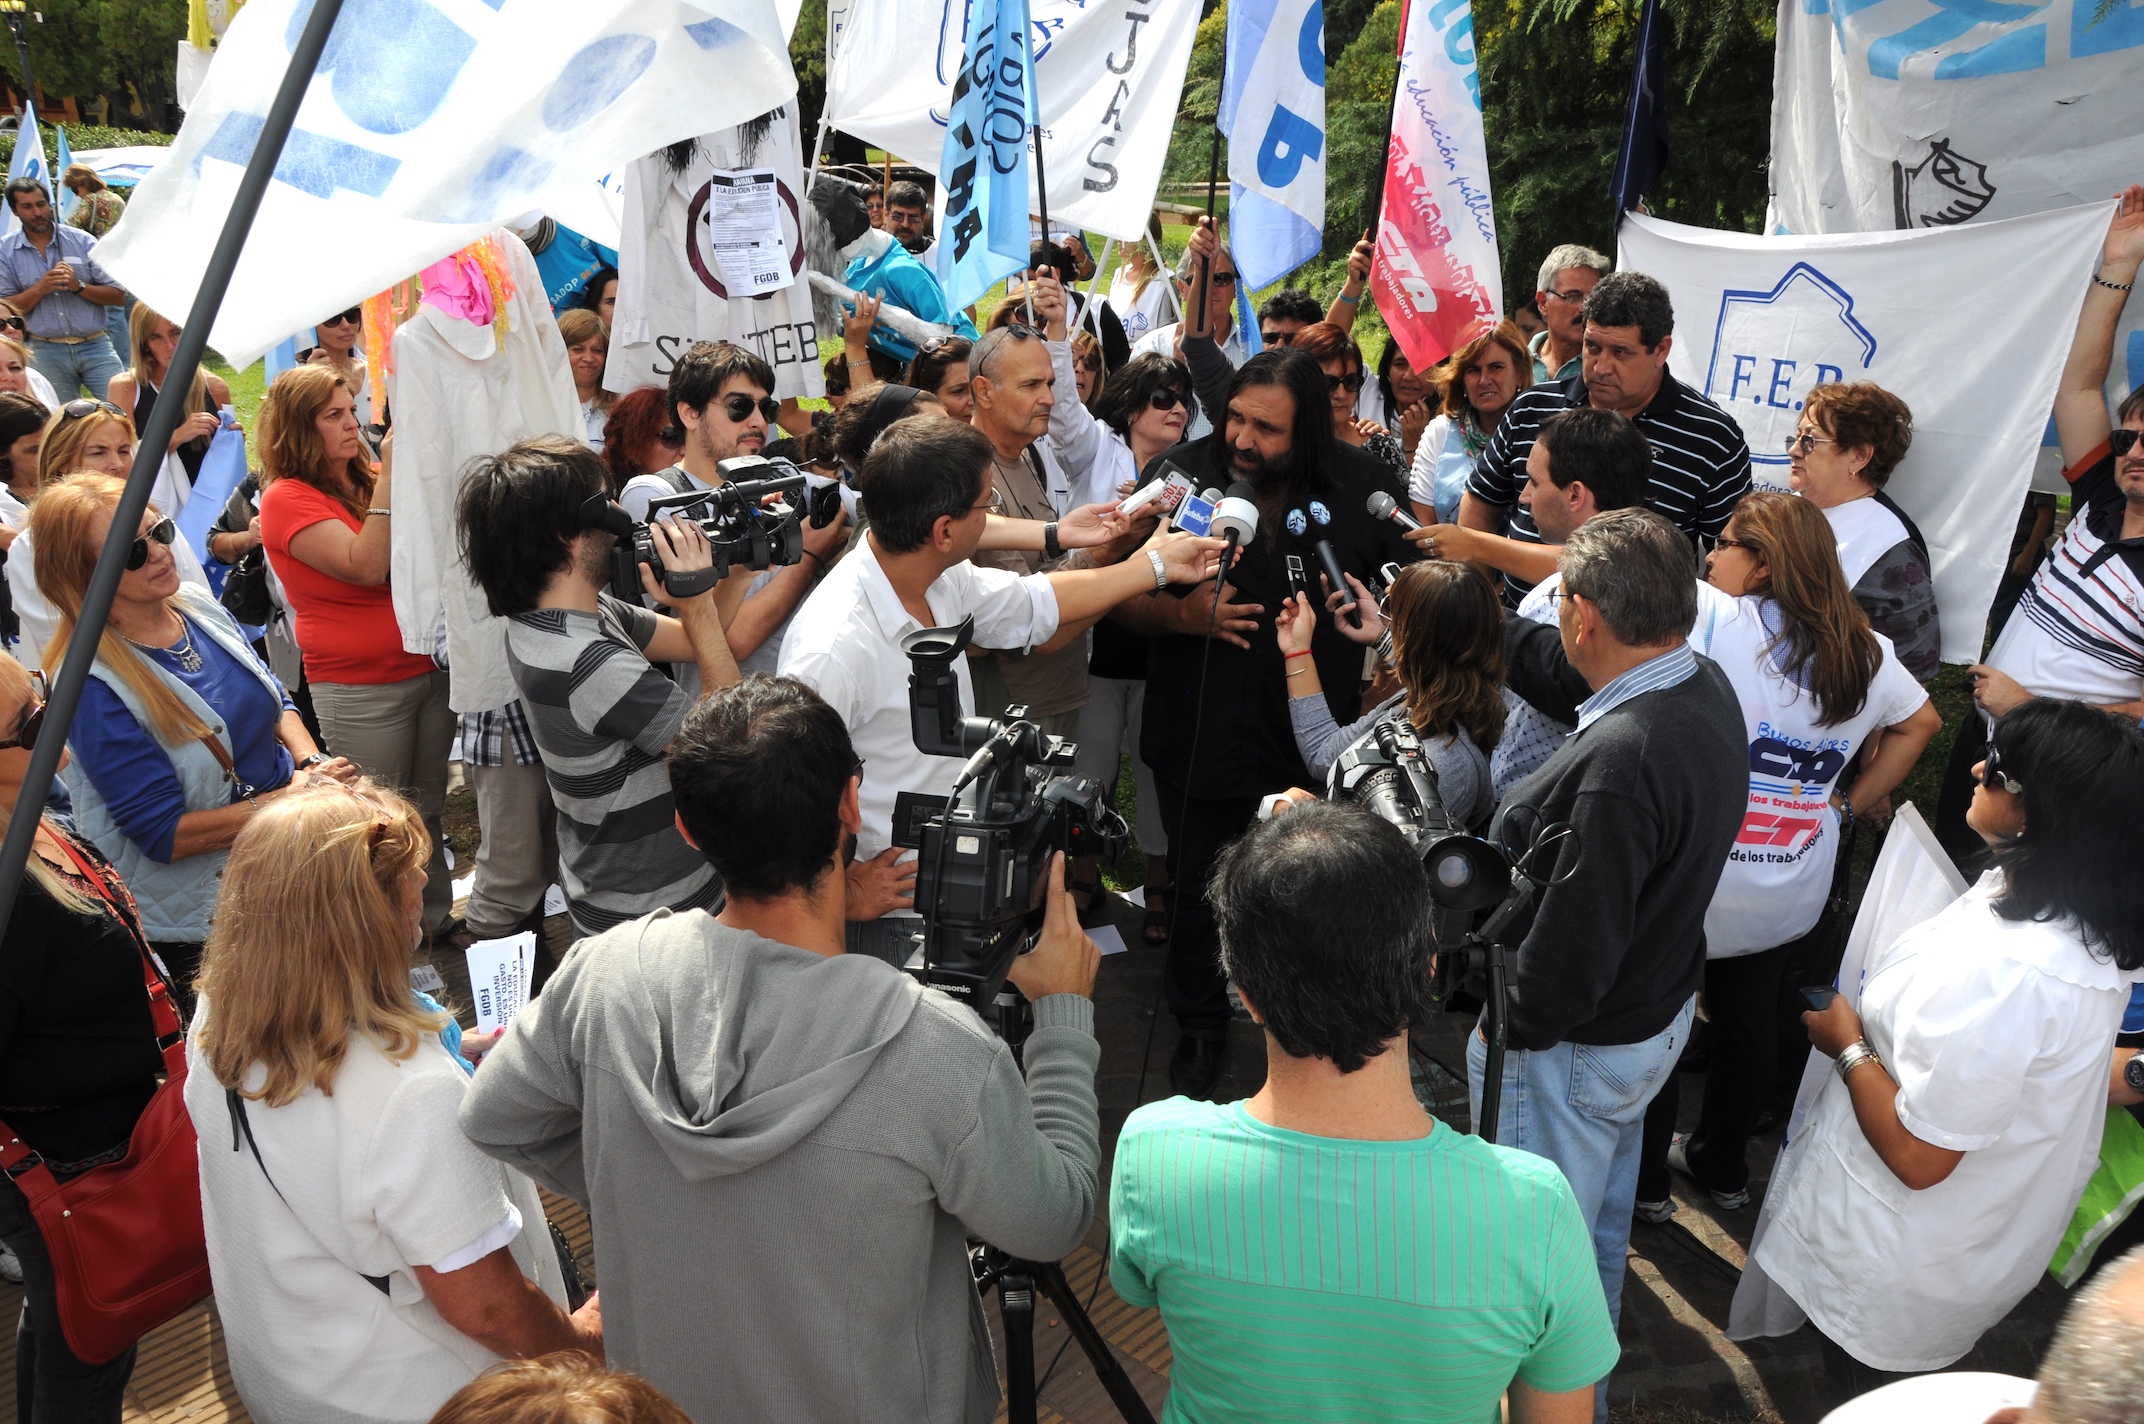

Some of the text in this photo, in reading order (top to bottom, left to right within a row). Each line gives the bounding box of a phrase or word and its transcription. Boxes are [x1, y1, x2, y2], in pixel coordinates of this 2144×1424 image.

[1406, 79, 1456, 171] educación
[1446, 176, 1494, 243] pública
[1378, 220, 1438, 312] CTA
[753, 272, 780, 284] FGDB
[550, 277, 579, 305] SADOP
[1378, 259, 1414, 320] trabajadores
[1749, 793, 1768, 805] los
[1729, 849, 1746, 862] de
[1748, 850, 1764, 862] los
[512, 960, 518, 973] LA
[507, 974, 513, 987] NO
[480, 988, 492, 1017] FGDB
[508, 990, 514, 1002] ES
[502, 998, 509, 1011] ES
